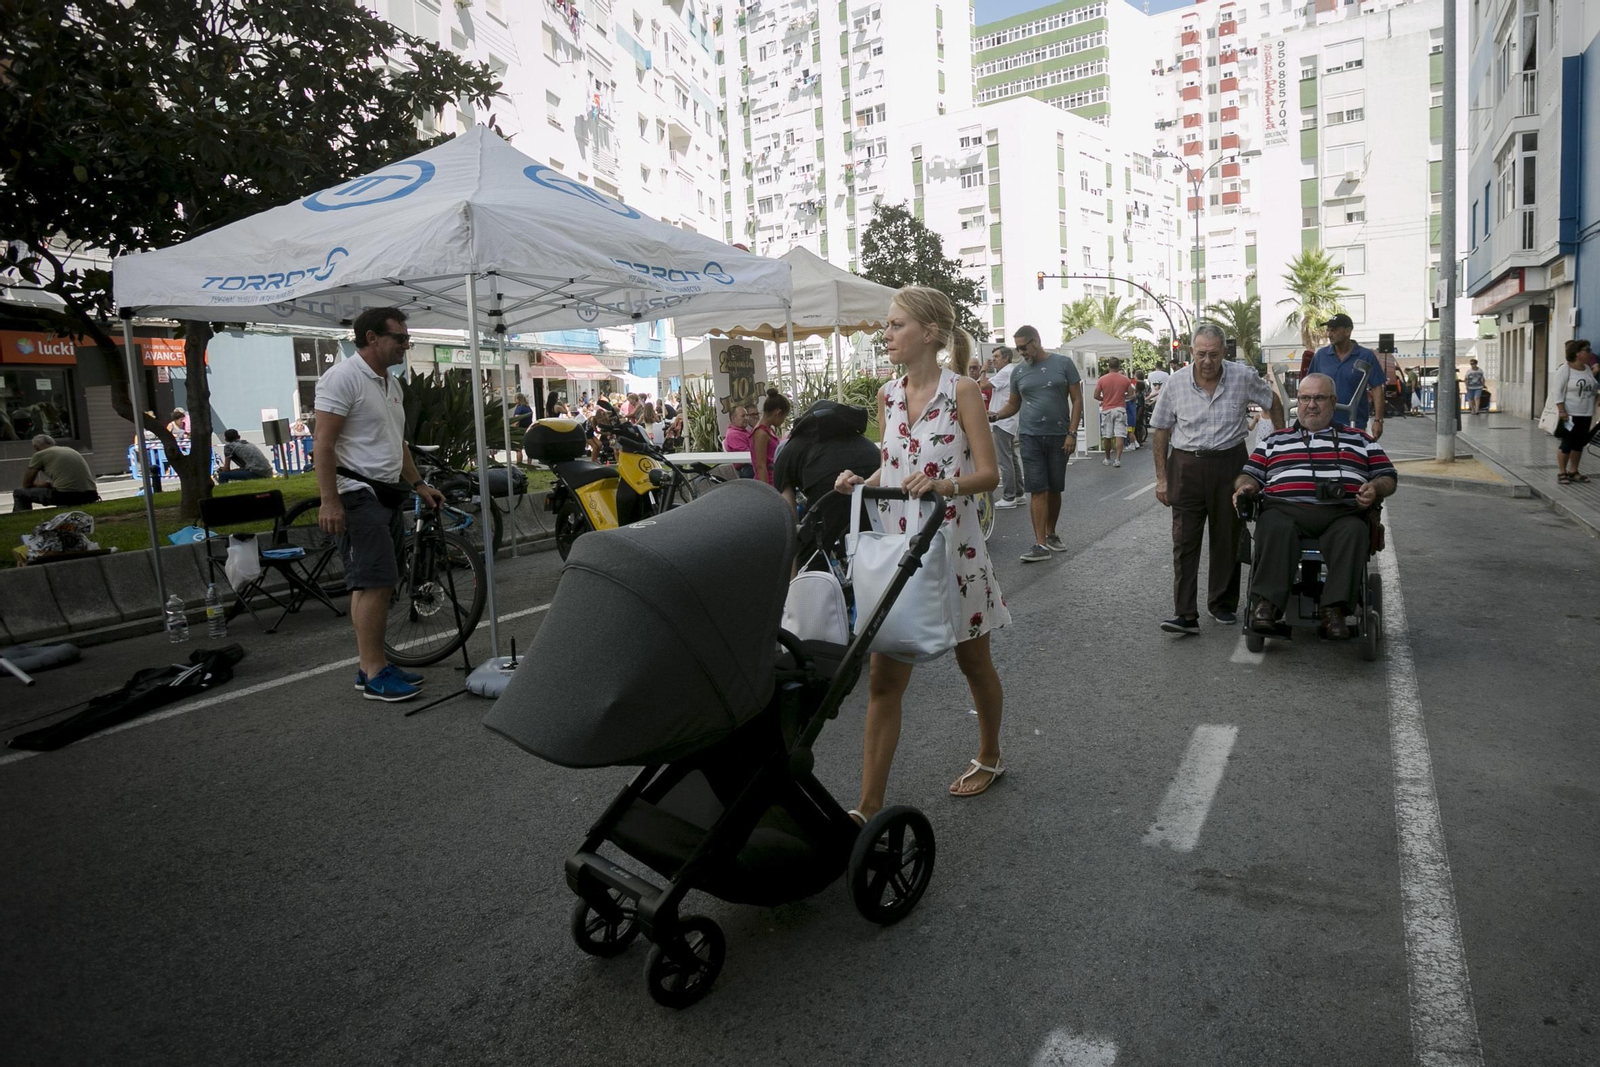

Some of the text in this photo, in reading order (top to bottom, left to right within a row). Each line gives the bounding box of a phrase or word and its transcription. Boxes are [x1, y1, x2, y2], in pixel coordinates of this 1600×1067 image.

[1278, 41, 1286, 68] 956
[1279, 100, 1287, 127] 704
[202, 266, 321, 291] TORROT
[37, 341, 75, 356] lucki
[144, 351, 183, 361] AVANCE
[325, 354, 334, 363] 20
